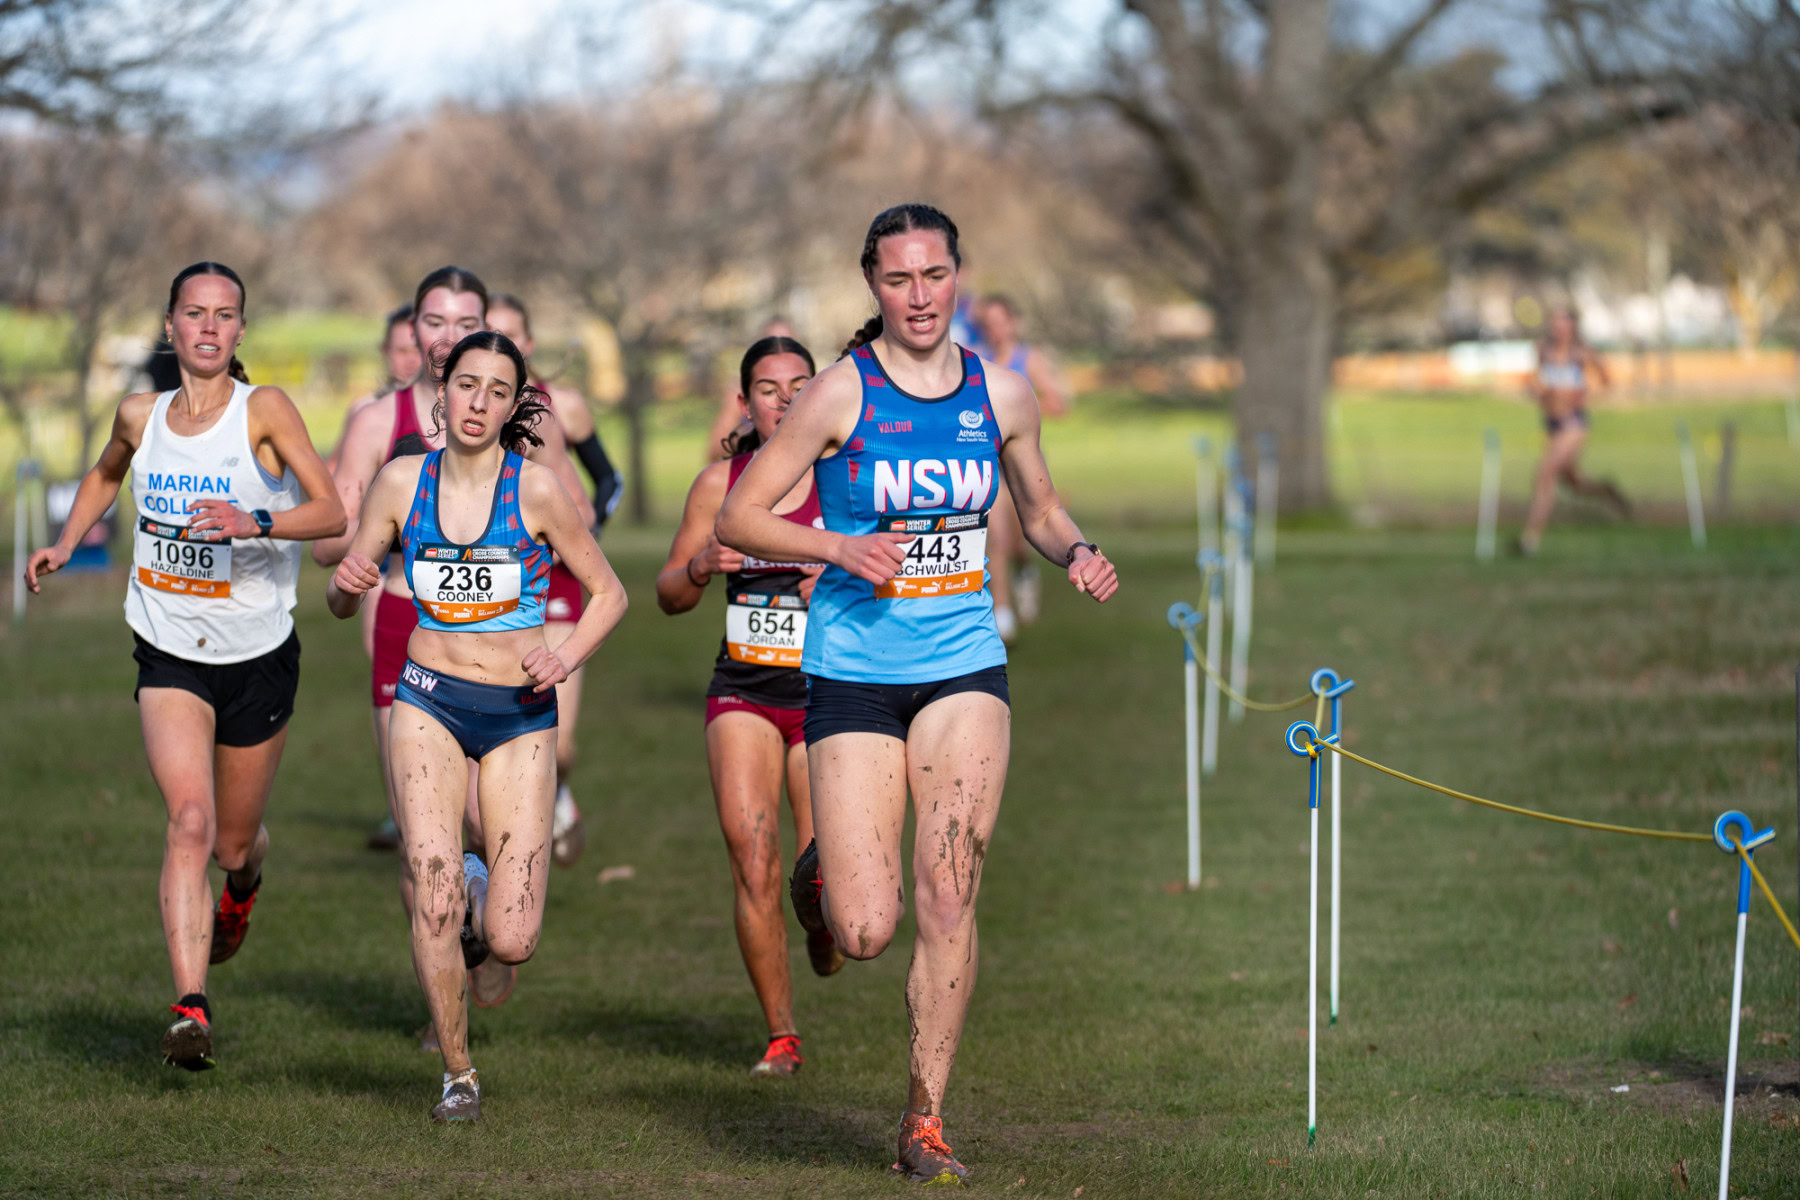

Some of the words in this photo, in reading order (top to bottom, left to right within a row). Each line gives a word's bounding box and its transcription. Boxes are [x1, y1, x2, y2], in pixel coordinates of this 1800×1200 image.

[878, 421, 912, 433] VALOUR
[959, 429, 987, 438] Athletics
[148, 473, 230, 493] MARIAN
[874, 459, 993, 512] NSW
[144, 495, 238, 515] COLL
[153, 540, 213, 569] 1096
[906, 535, 960, 563] 443
[150, 560, 214, 579] HAZELDINE
[438, 565, 492, 591] 236
[437, 591, 494, 602] COONEY
[748, 610, 796, 636] 654
[746, 635, 795, 646] JORDAN
[402, 664, 438, 692] NSW
